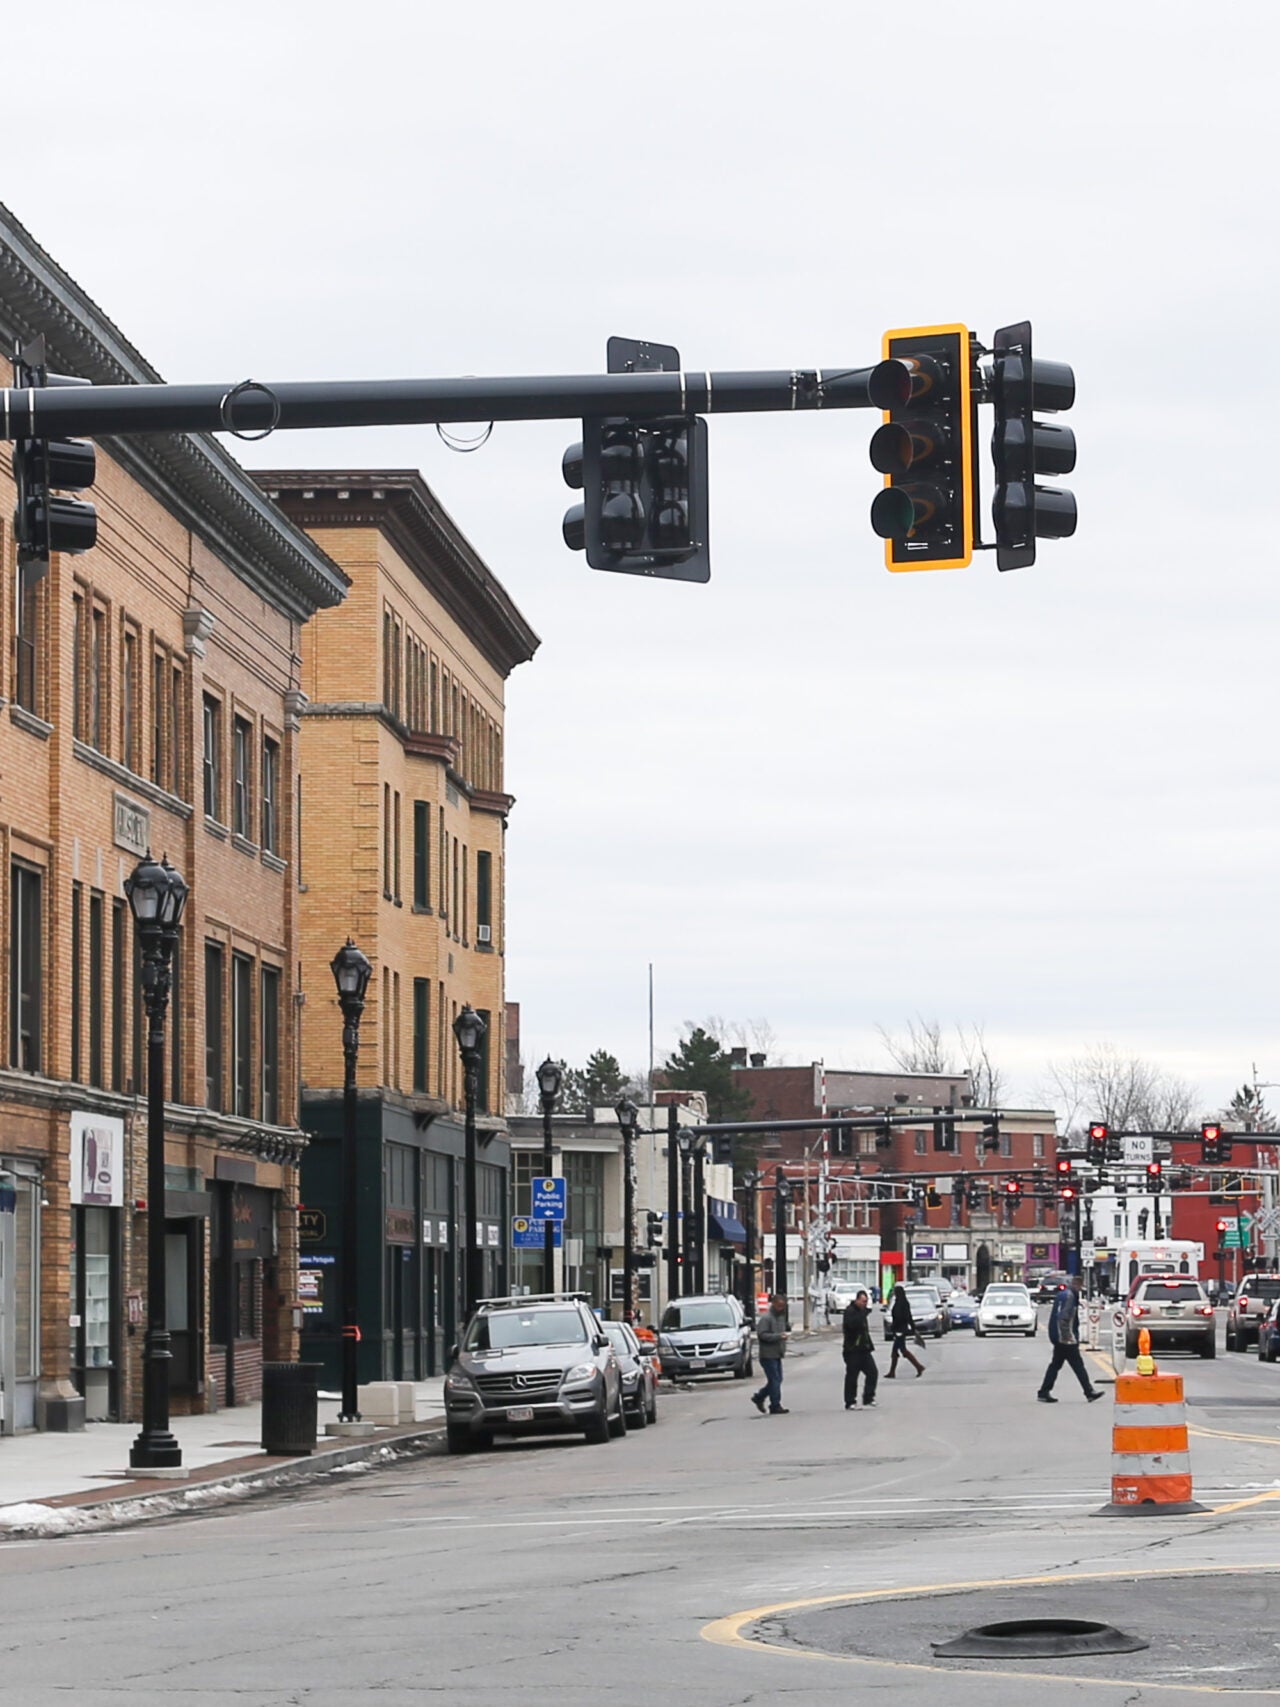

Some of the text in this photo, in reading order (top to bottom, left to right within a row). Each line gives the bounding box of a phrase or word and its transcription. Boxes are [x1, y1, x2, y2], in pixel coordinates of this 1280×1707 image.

[1131, 1140, 1146, 1150] NO
[1125, 1153, 1152, 1161] TURNS
[534, 1201, 563, 1209] Parking
